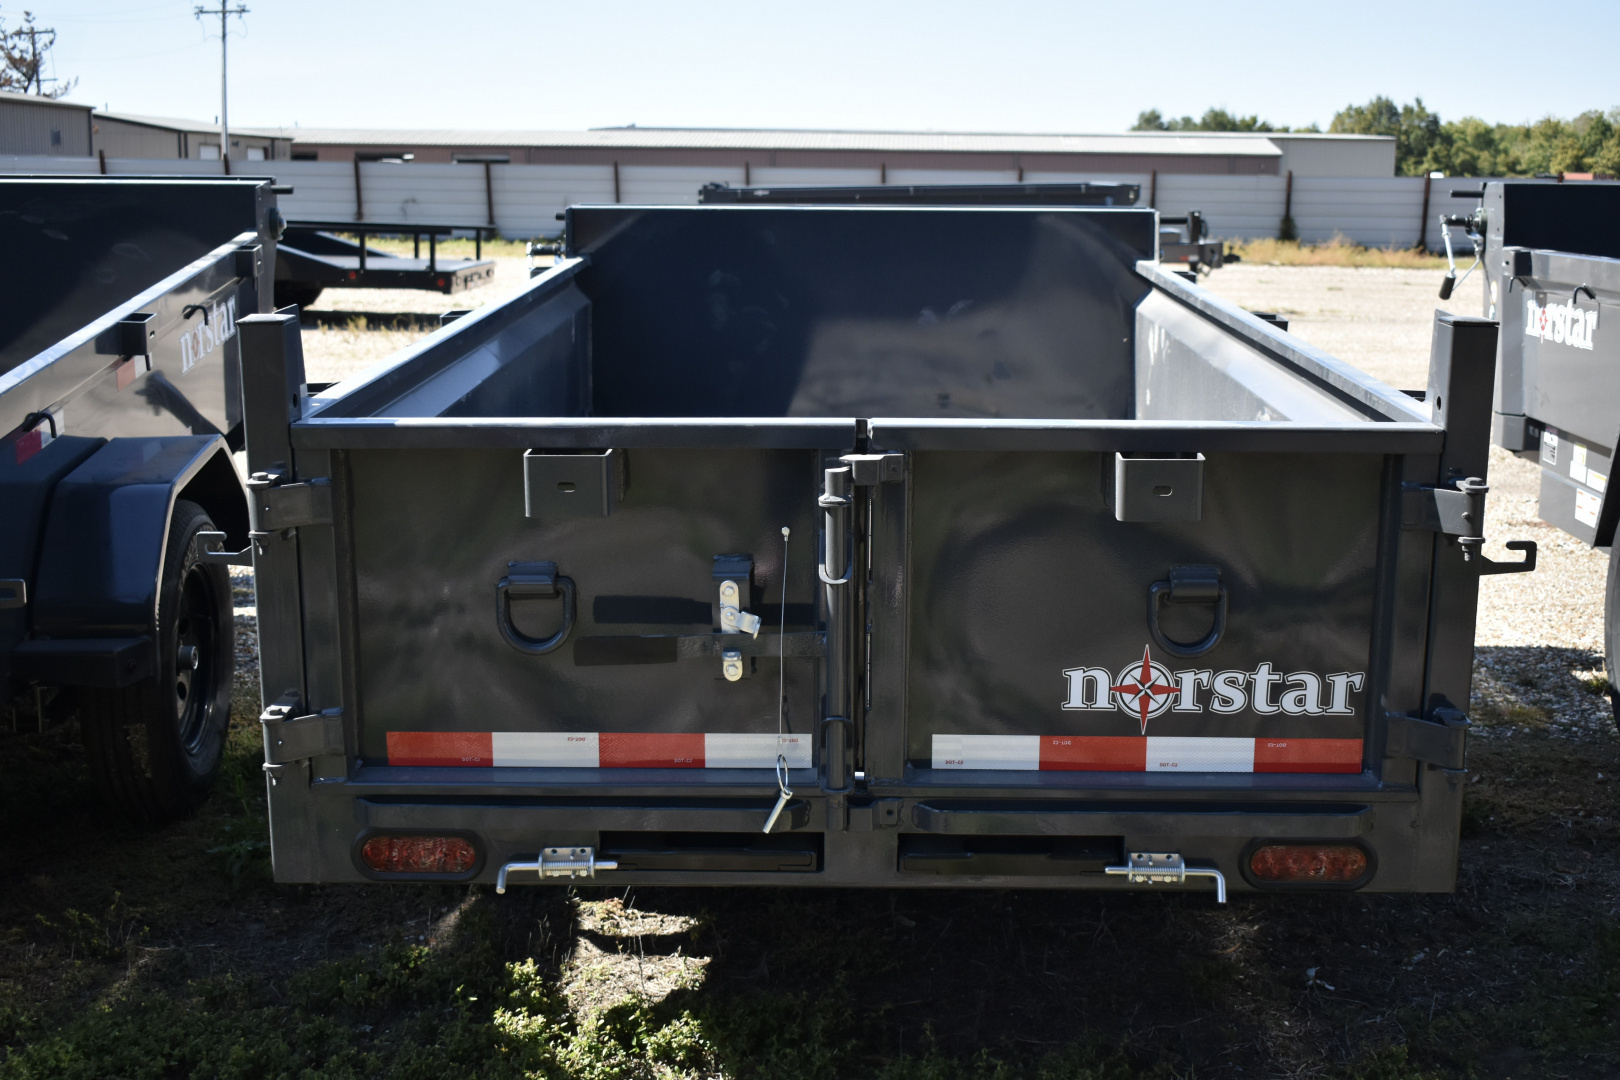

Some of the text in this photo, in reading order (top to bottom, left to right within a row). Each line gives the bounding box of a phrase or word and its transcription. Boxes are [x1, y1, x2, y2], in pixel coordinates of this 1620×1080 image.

[179, 295, 237, 375] norstar
[1525, 298, 1598, 351] norstar
[1061, 660, 1365, 719] norstar
